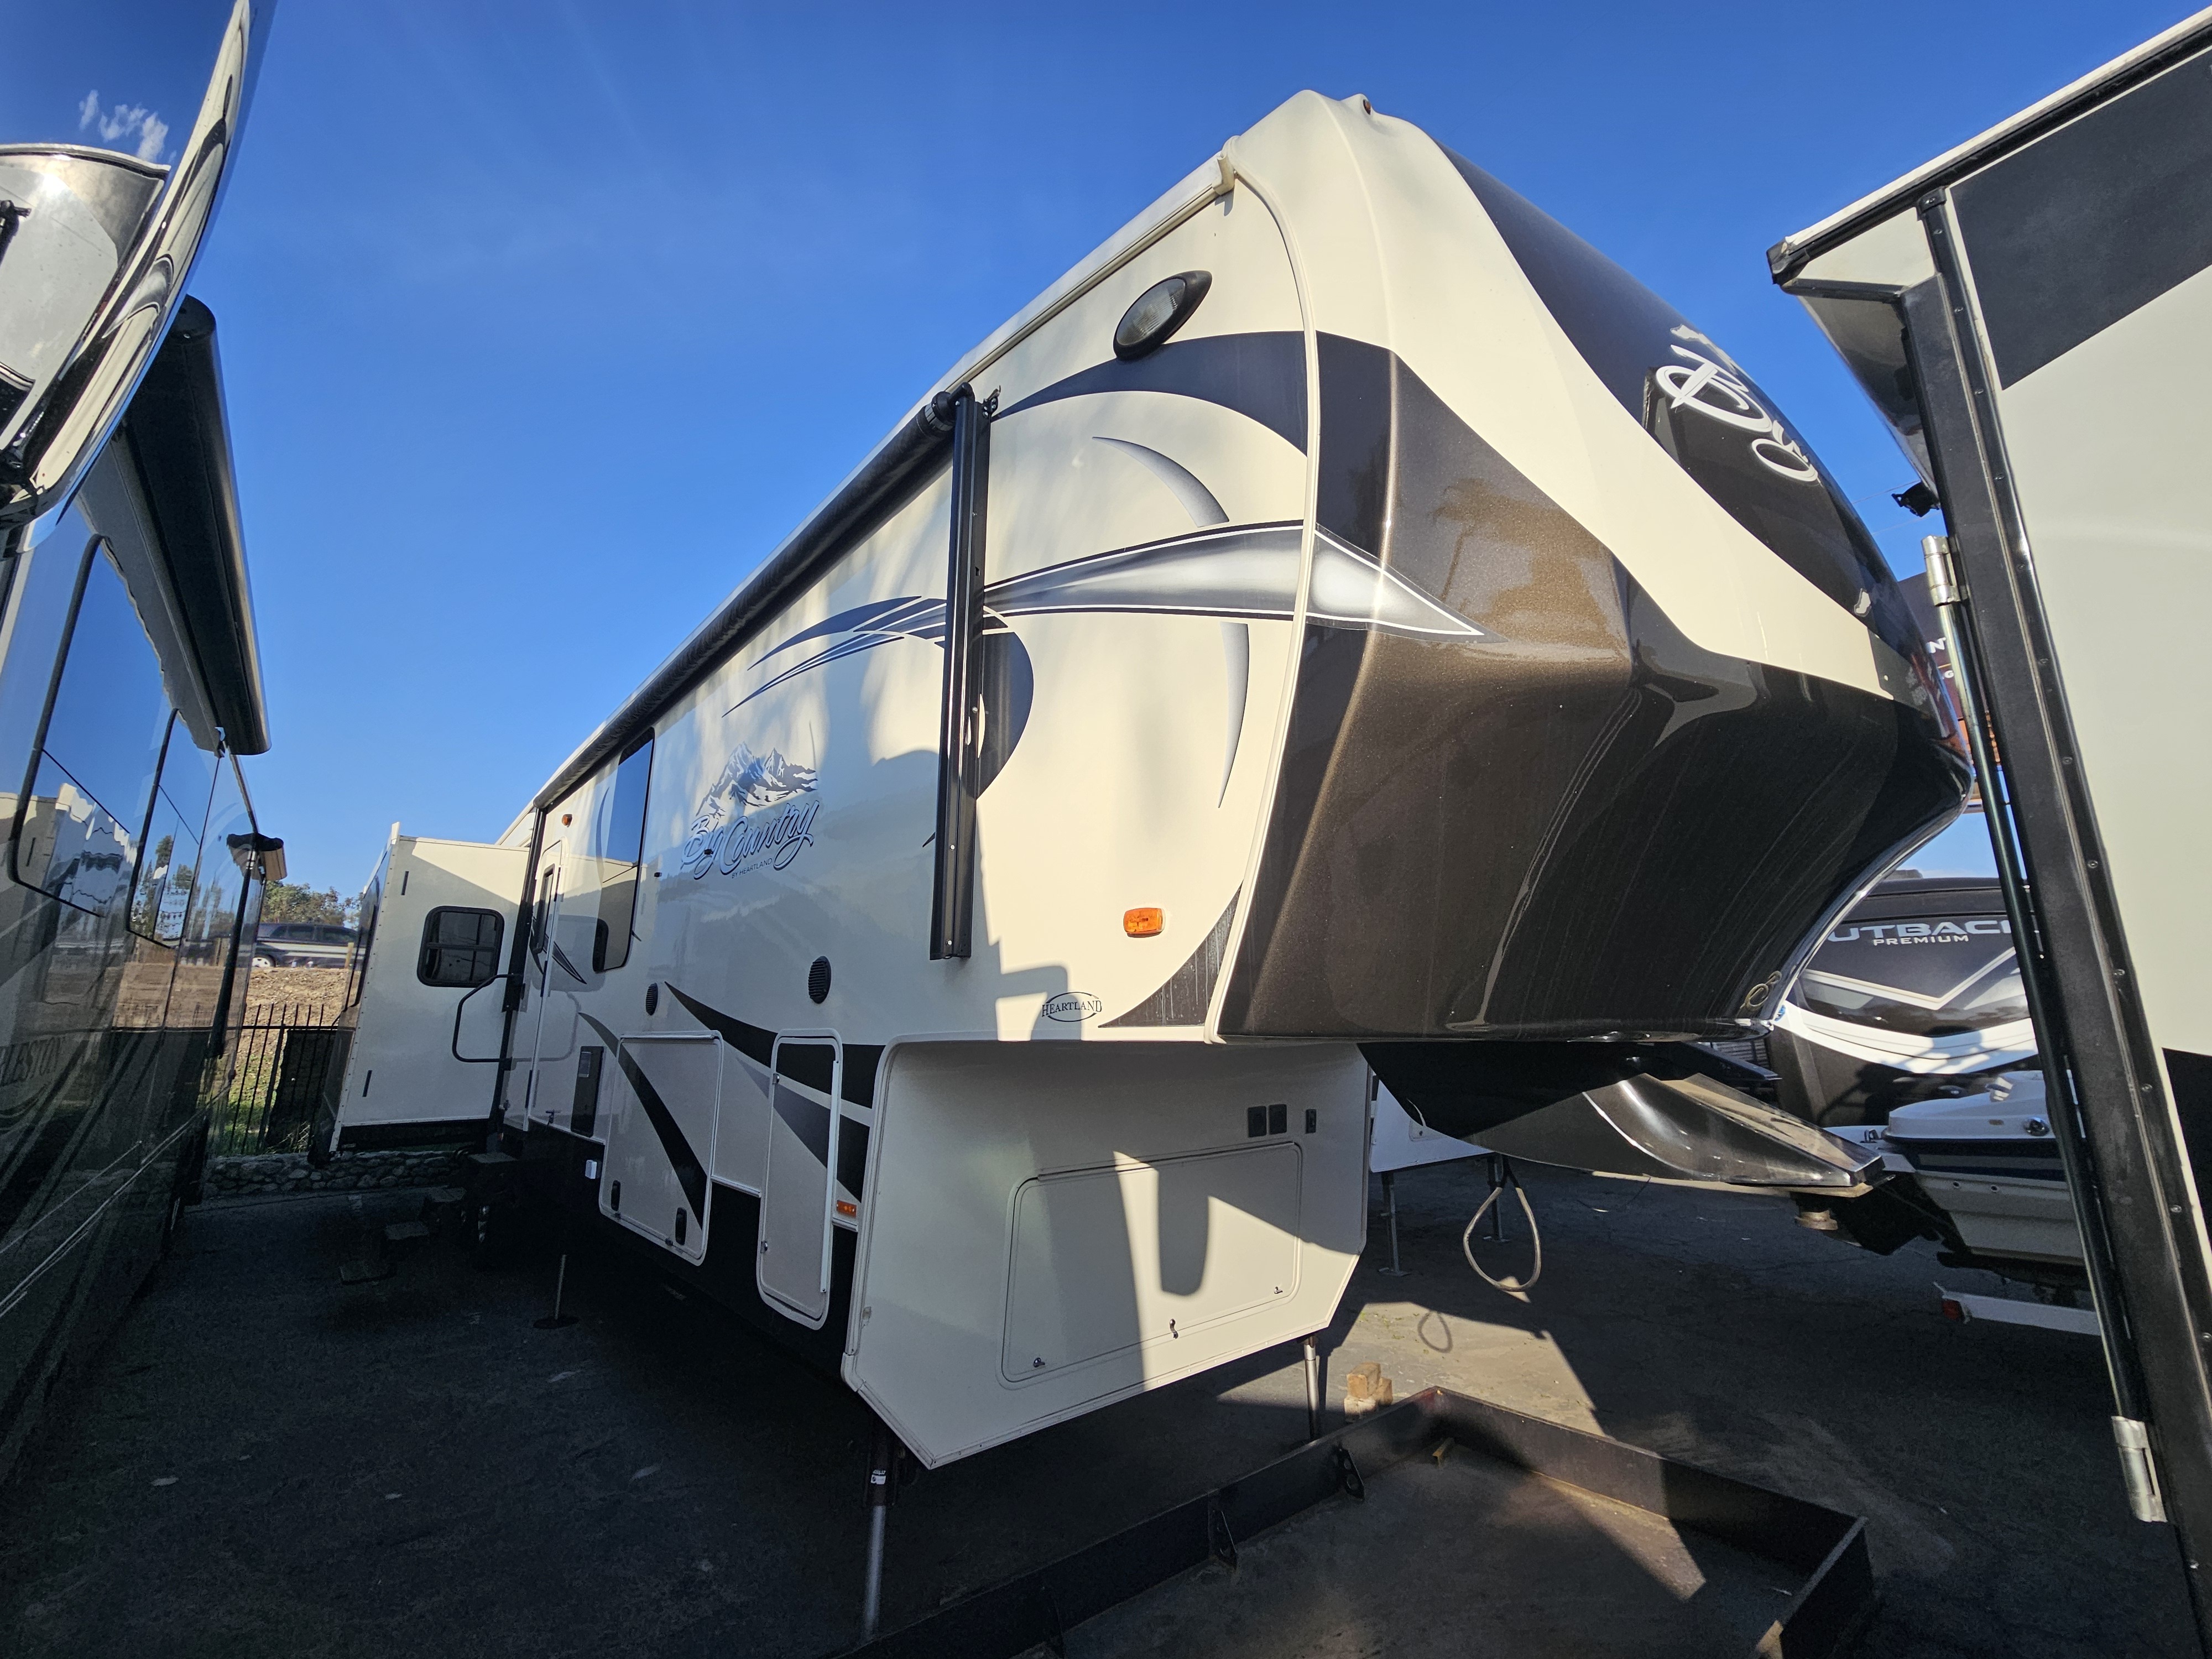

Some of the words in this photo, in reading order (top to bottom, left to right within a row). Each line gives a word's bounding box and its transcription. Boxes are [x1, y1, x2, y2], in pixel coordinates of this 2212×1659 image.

[680, 814, 724, 880] Big
[719, 800, 820, 875] Country
[731, 871, 739, 879] BY
[739, 858, 773, 876] HEARTLAND
[1827, 920, 2012, 942] UTBAC
[1873, 935, 1969, 946] PREMIUM
[1041, 1000, 1103, 1018] HEARTLAND
